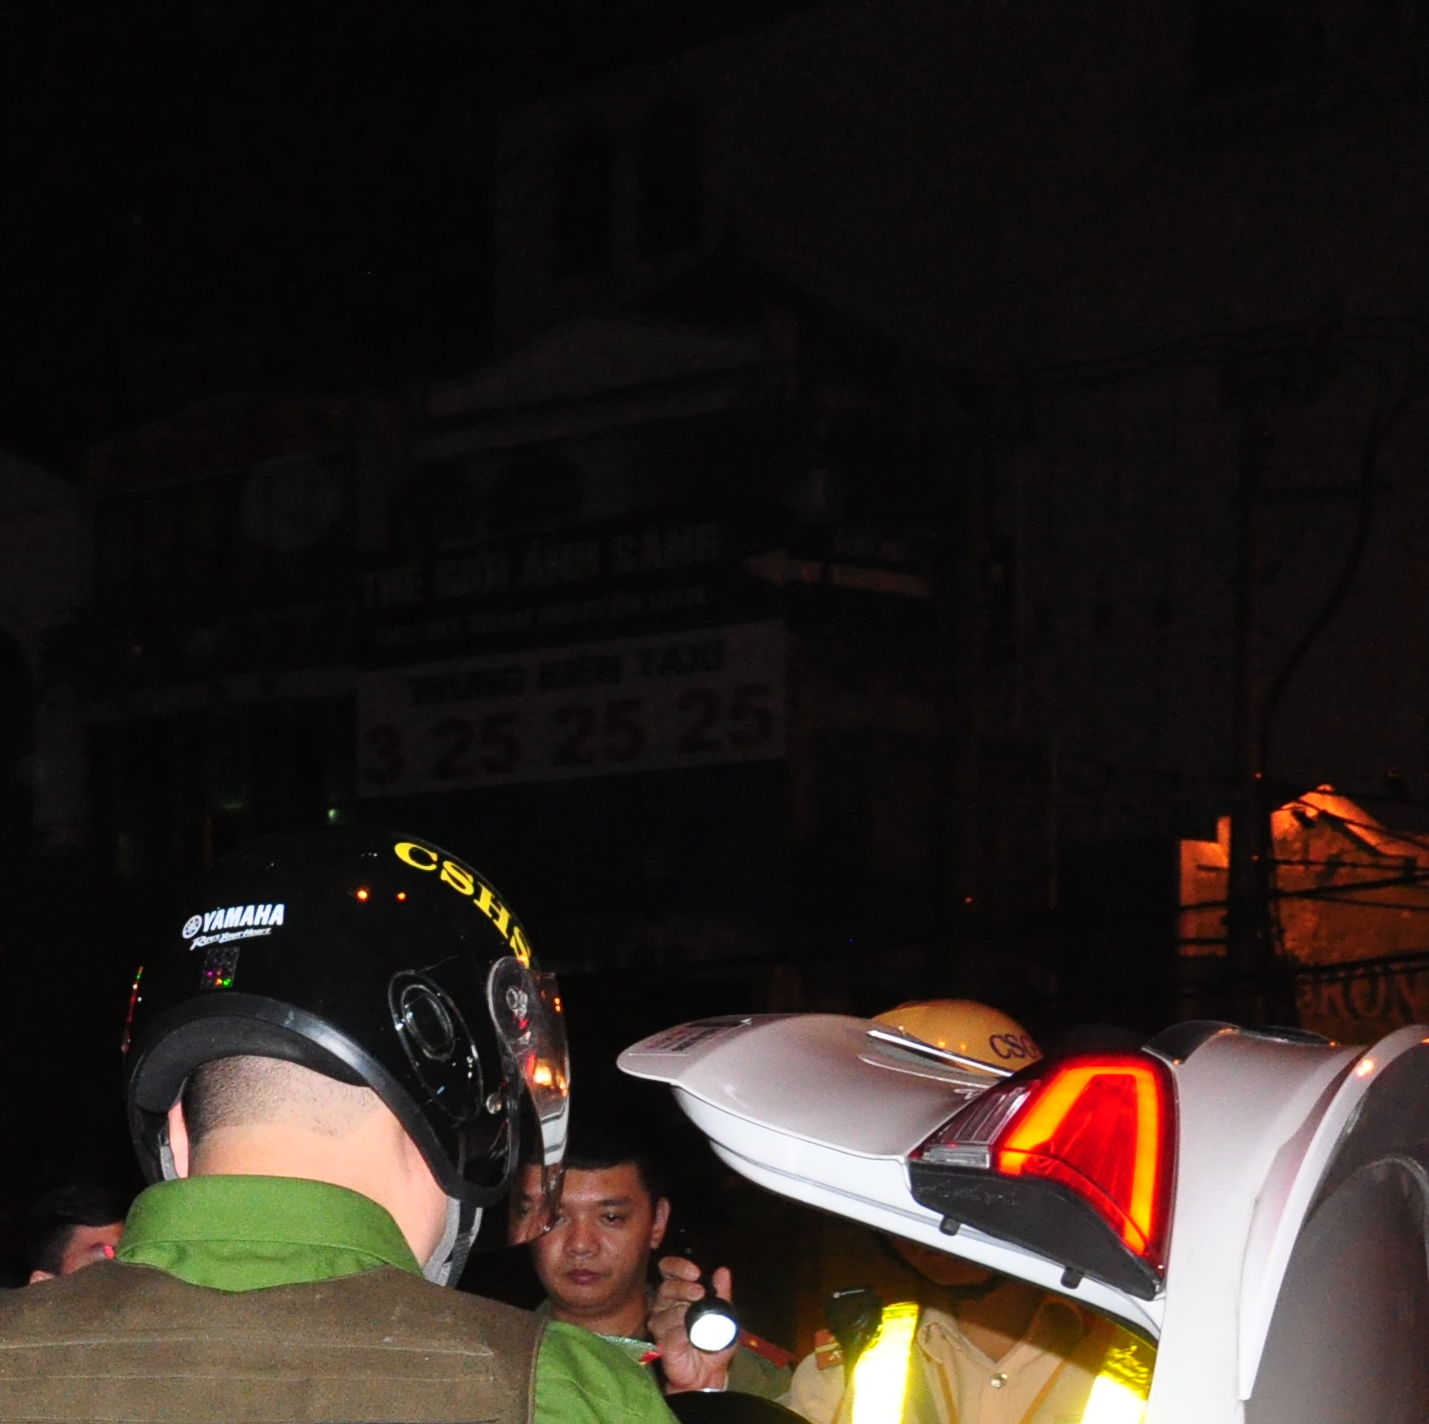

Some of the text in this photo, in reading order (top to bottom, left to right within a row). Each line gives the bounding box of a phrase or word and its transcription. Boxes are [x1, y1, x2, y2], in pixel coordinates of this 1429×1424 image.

[364, 684, 773, 785] 3 25 25 25
[203, 903, 284, 932] YAMAHA
[394, 841, 531, 968] CSHS
